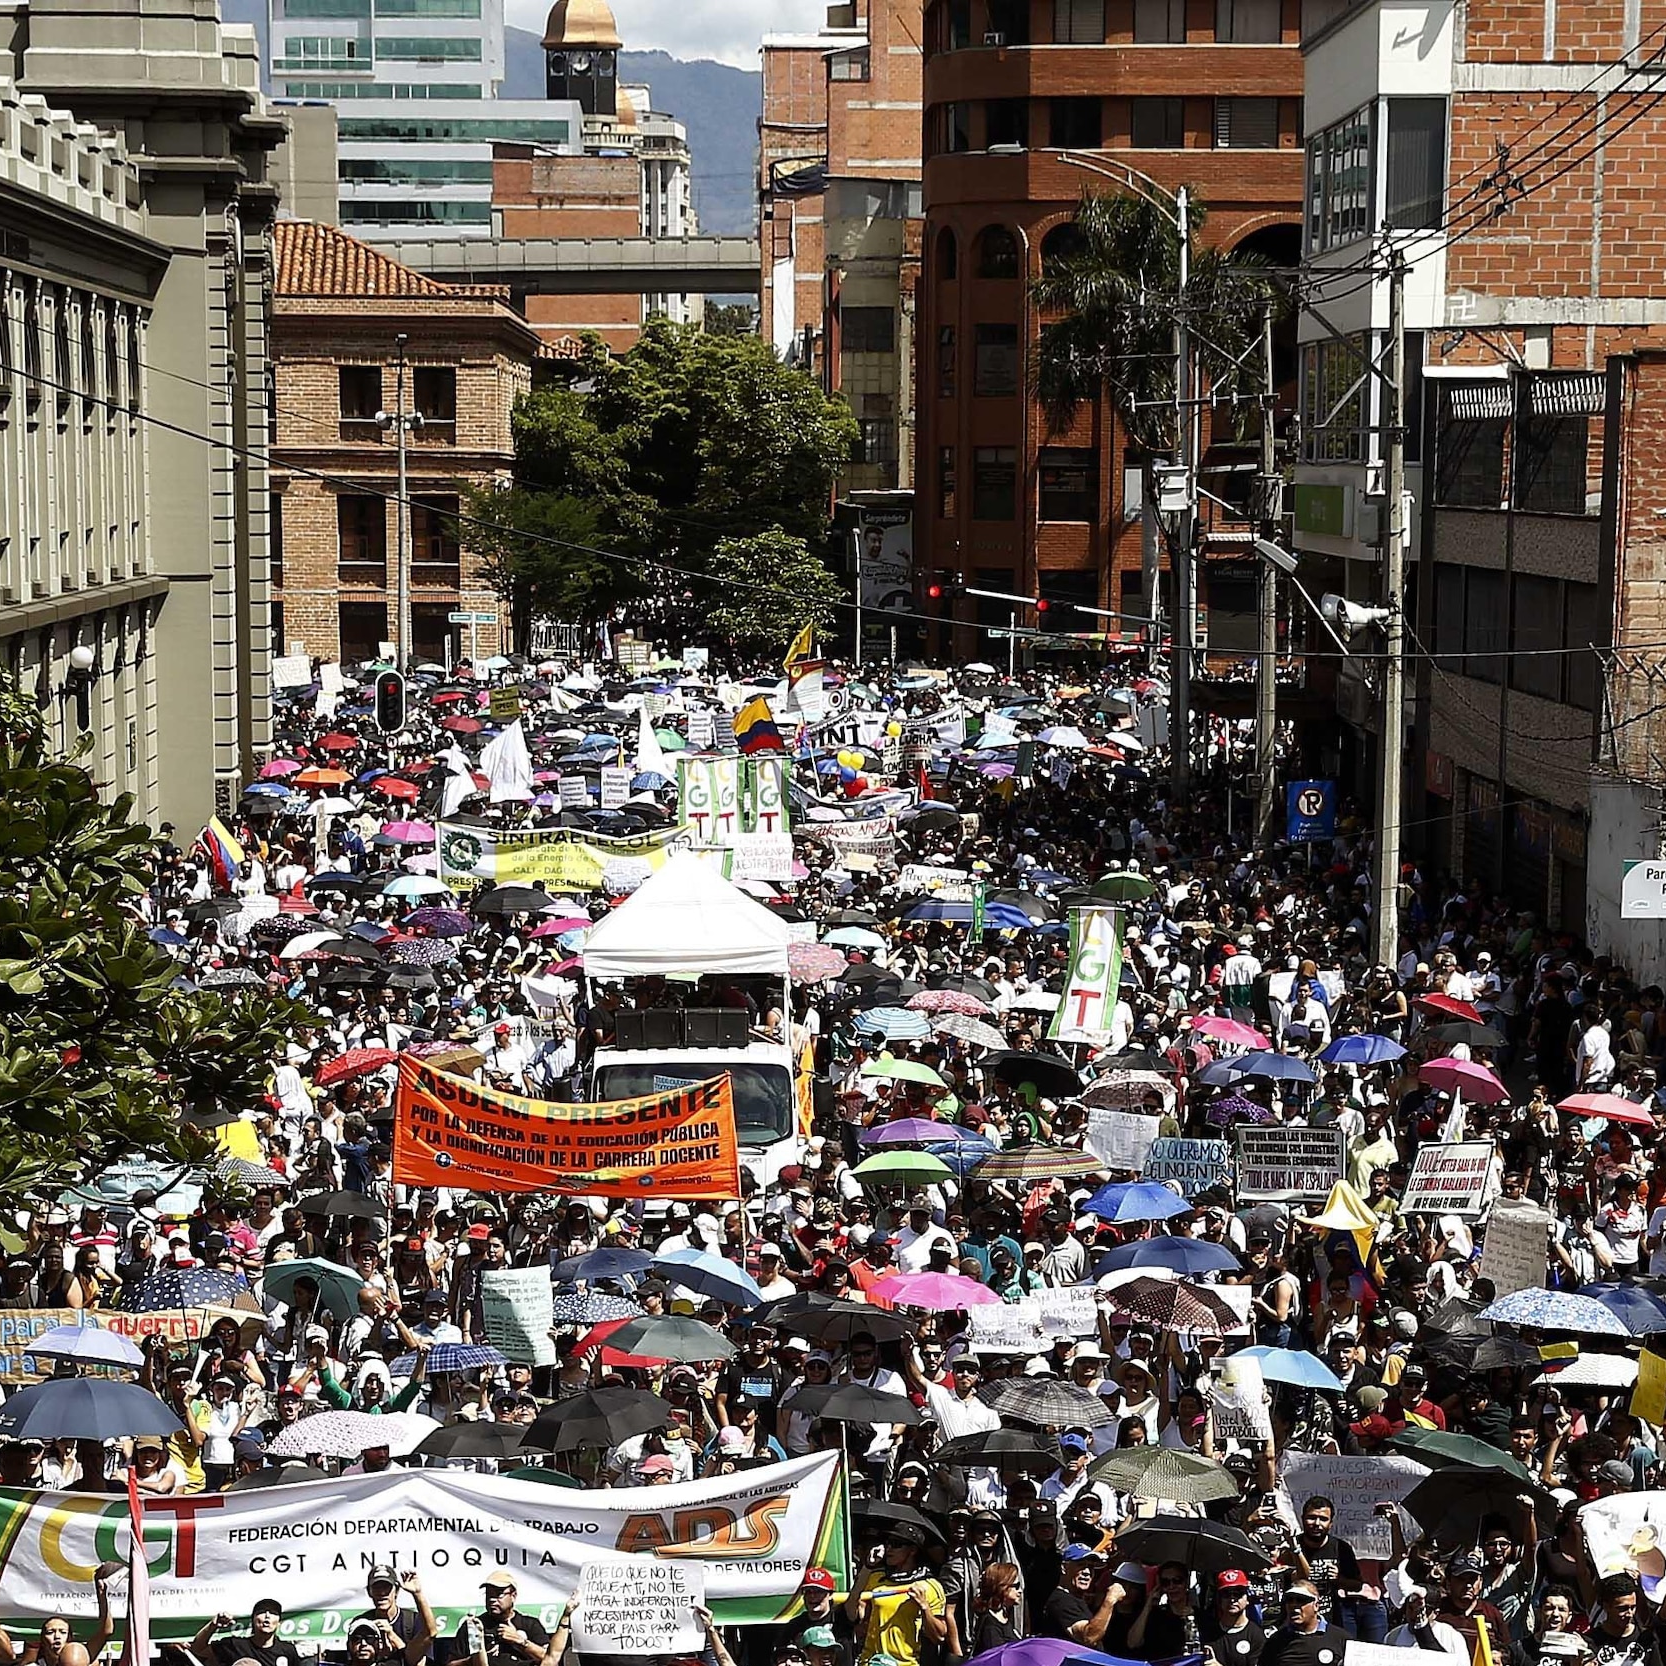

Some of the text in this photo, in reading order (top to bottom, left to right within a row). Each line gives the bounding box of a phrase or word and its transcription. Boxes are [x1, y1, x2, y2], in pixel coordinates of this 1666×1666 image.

[415, 1067, 721, 1126] ASDEM PRESENTE
[411, 1105, 720, 1147] POR LA DEFENSA DE LA EDUCACIÓN PÚBLICA
[411, 1126, 720, 1166] Y LA DIGNIFICACIÓN DE LA CARRERA DOCENTE
[1149, 1141, 1227, 1163] NO QUEREMOS
[1, 1316, 59, 1346] para
[108, 1314, 198, 1341] guerra
[1215, 1412, 1239, 1428] Usted
[229, 1518, 337, 1543] FEDERACIÓN
[344, 1516, 484, 1537] DEPARTAMENTAL
[524, 1517, 600, 1536] TRABAJO
[614, 1495, 791, 1558] ADS
[39, 1495, 224, 1583] CGT
[249, 1546, 558, 1575] CGT ANTIOQUIA
[586, 1564, 685, 1580] QUE LO QUE NO TE
[716, 1559, 803, 1577] DE VALORES
[620, 1582, 632, 1594] A
[648, 1582, 666, 1594] NO
[669, 1582, 686, 1594] TE
[584, 1595, 621, 1608] HAGA
[584, 1608, 676, 1623] NECESITAMOS UN
[650, 1622, 681, 1634] PARA
